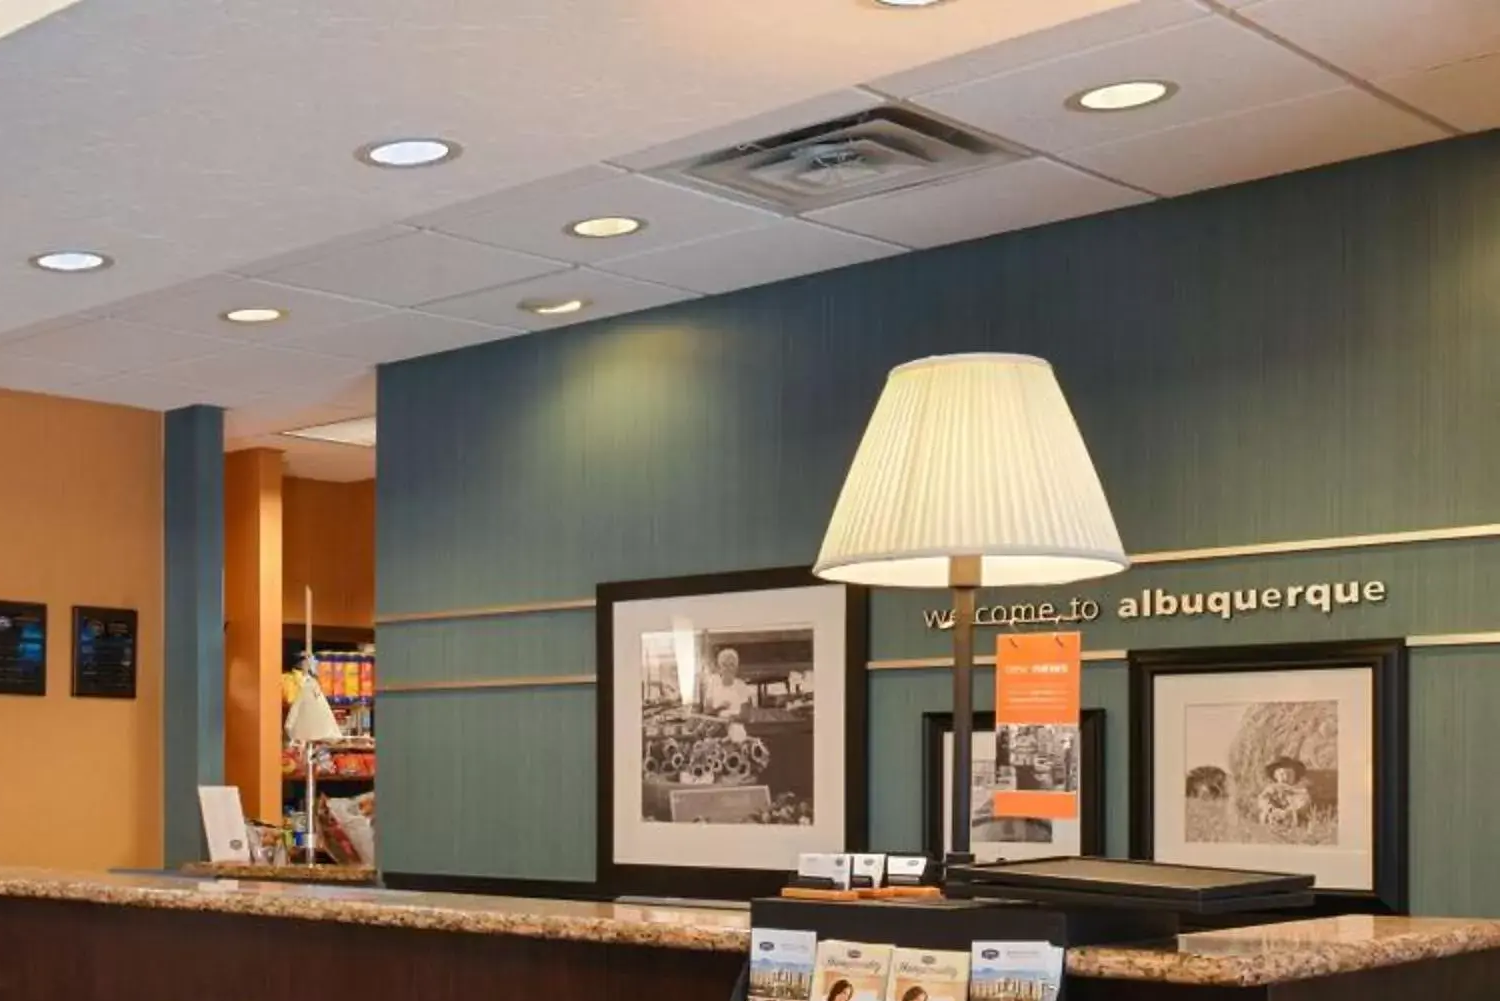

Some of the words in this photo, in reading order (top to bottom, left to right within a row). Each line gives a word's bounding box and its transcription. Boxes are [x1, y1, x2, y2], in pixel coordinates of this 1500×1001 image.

[923, 602, 1054, 629] wecome
[1070, 597, 1099, 620] to
[1117, 580, 1385, 619] albuquerque
